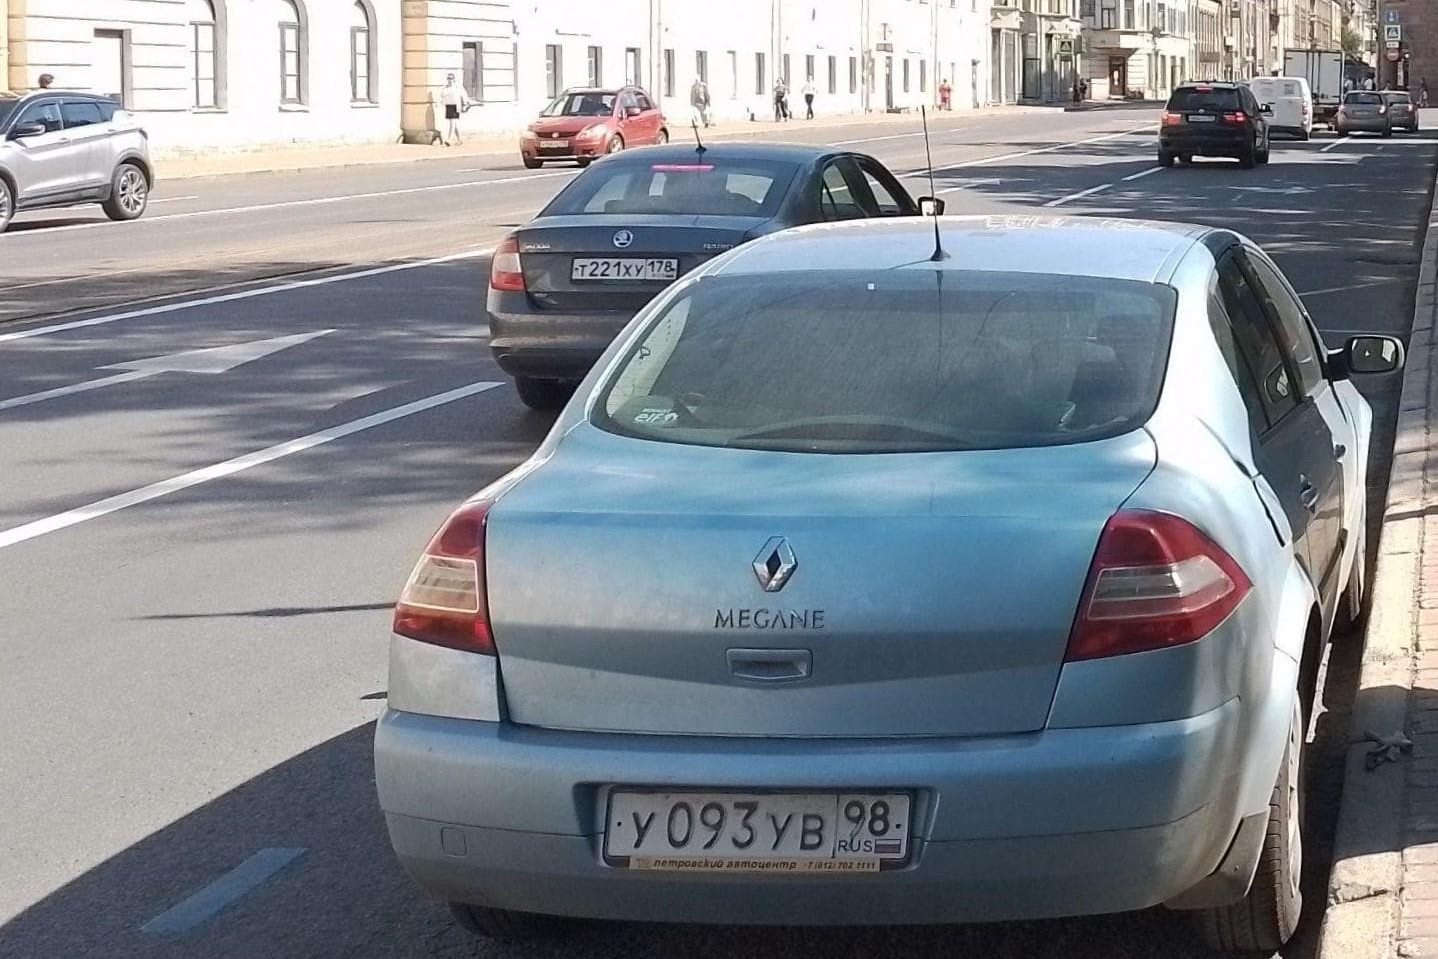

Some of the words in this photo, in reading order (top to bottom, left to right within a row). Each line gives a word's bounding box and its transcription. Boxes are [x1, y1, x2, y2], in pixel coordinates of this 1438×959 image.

[647, 260, 673, 272] 178
[714, 608, 825, 629] MEGANE
[843, 799, 890, 839] 98
[837, 839, 873, 853] RUS
